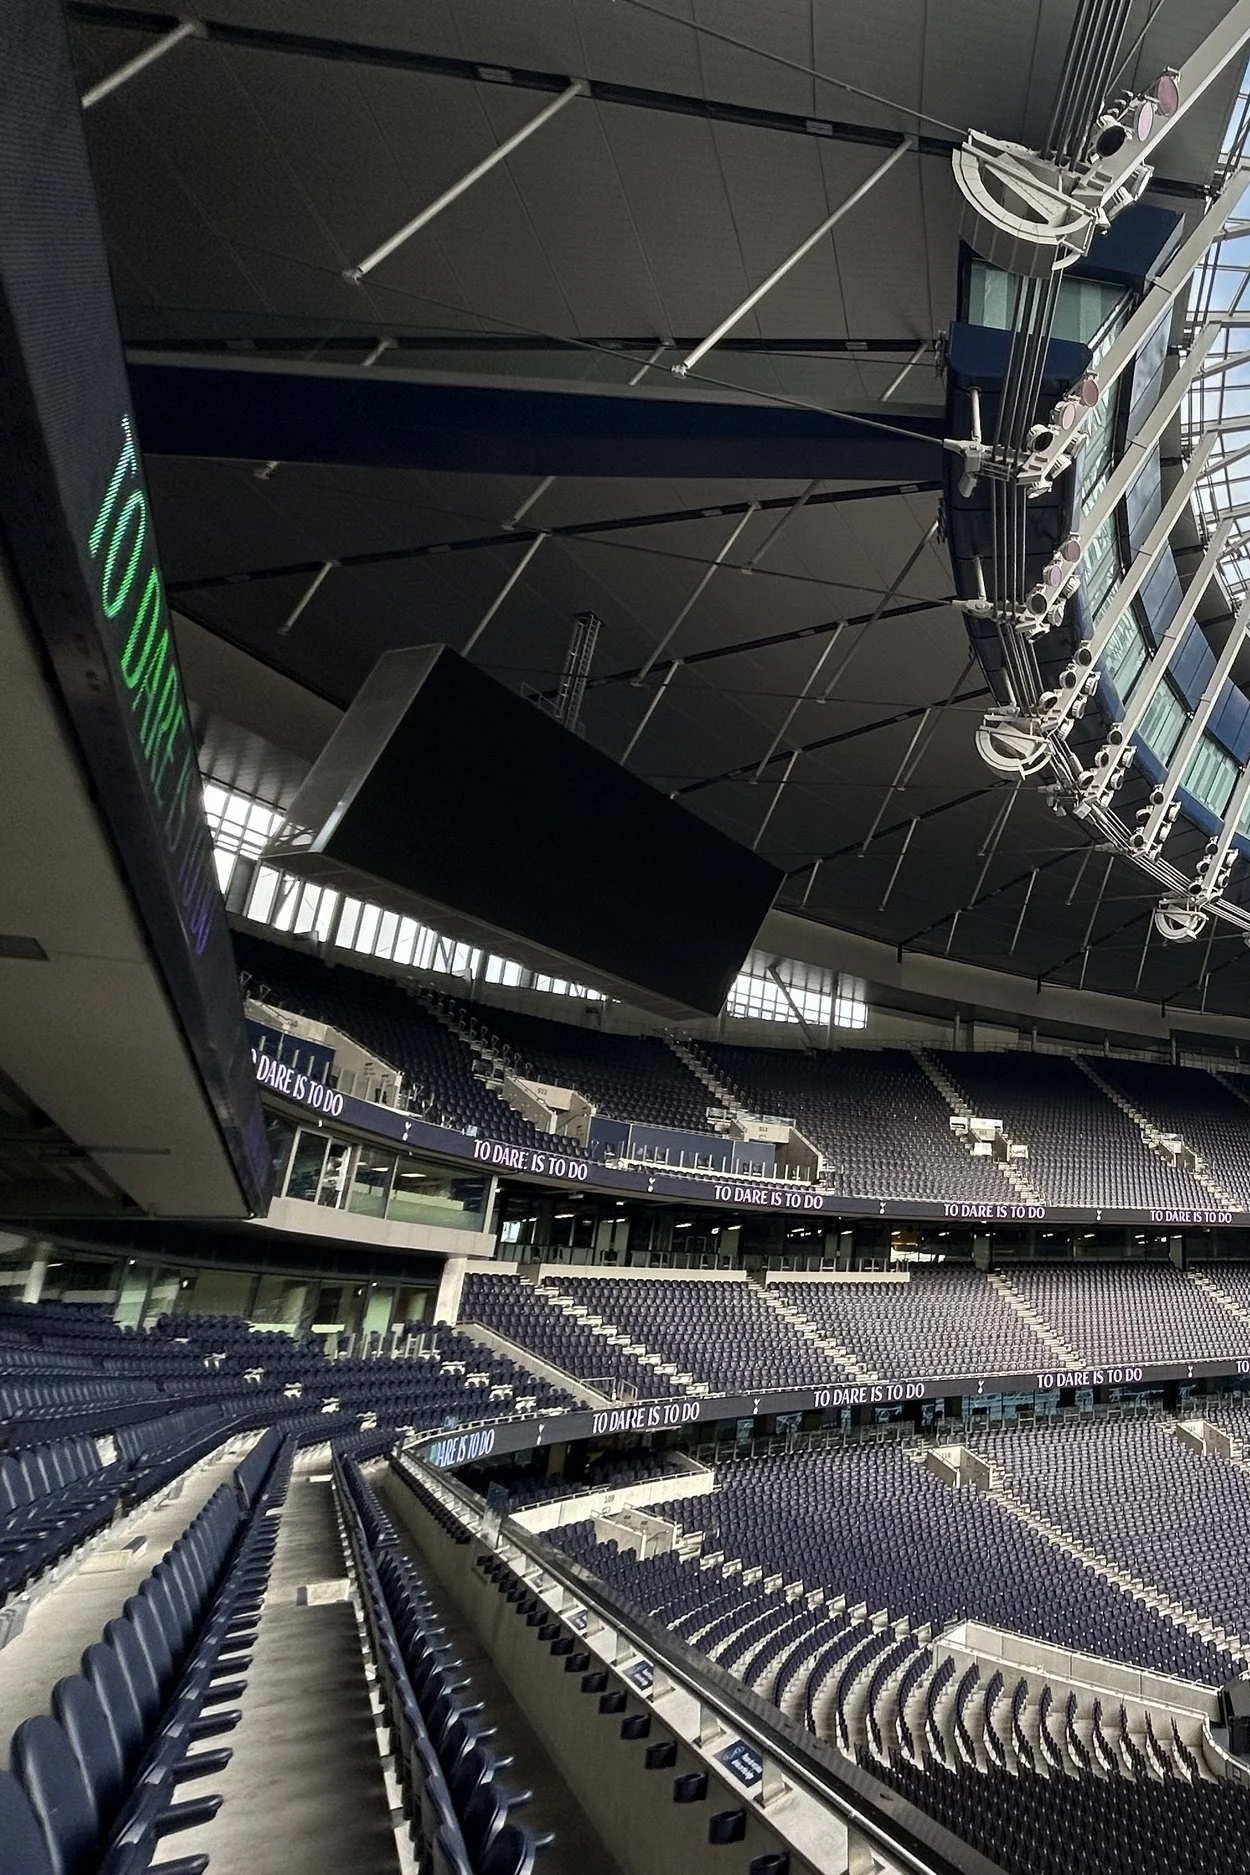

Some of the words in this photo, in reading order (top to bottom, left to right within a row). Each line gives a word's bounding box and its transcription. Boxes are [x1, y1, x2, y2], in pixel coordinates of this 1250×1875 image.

[88, 414, 146, 619] TO
[256, 1055, 294, 1094] DARE
[293, 1074, 308, 1100] IS
[307, 1081, 324, 1108] TO
[323, 1089, 344, 1117] DO
[474, 1139, 491, 1161] TO
[492, 1145, 529, 1170] DARE
[531, 1154, 545, 1173] IS
[549, 1157, 565, 1176] TO
[568, 1161, 588, 1180] DO
[714, 1185, 731, 1201] TO
[734, 1187, 768, 1205] DARE
[771, 1192, 782, 1206] IS
[786, 1193, 801, 1207] TO
[804, 1194, 823, 1209] DO
[944, 1204, 958, 1216] TO
[961, 1205, 993, 1217] DARE
[996, 1206, 1008, 1218] IS
[1010, 1206, 1026, 1219] TO
[1028, 1206, 1045, 1219] DO
[1150, 1210, 1163, 1222] TO
[1166, 1211, 1191, 1222] DARE
[1194, 1212, 1202, 1223] IS
[1204, 1212, 1216, 1223] TO
[1218, 1212, 1232, 1223] DO
[1037, 1374, 1053, 1388] TO
[1057, 1371, 1089, 1387] DARE
[1093, 1370, 1104, 1385] IS
[1107, 1369, 1122, 1383] TO
[1126, 1368, 1142, 1382] DO
[1236, 1360, 1249, 1373] TO
[814, 1390, 830, 1407] TO
[833, 1387, 867, 1405] DARE
[871, 1386, 882, 1402] IS
[886, 1384, 903, 1400] TO
[906, 1382, 925, 1399] DO
[593, 1412, 608, 1434] TO
[609, 1408, 645, 1431] DARE
[648, 1406, 660, 1426] IS
[664, 1404, 679, 1424] TO
[681, 1402, 700, 1421] DO
[456, 1435, 468, 1462] IS
[467, 1432, 480, 1459] TO
[478, 1429, 495, 1456] DO
